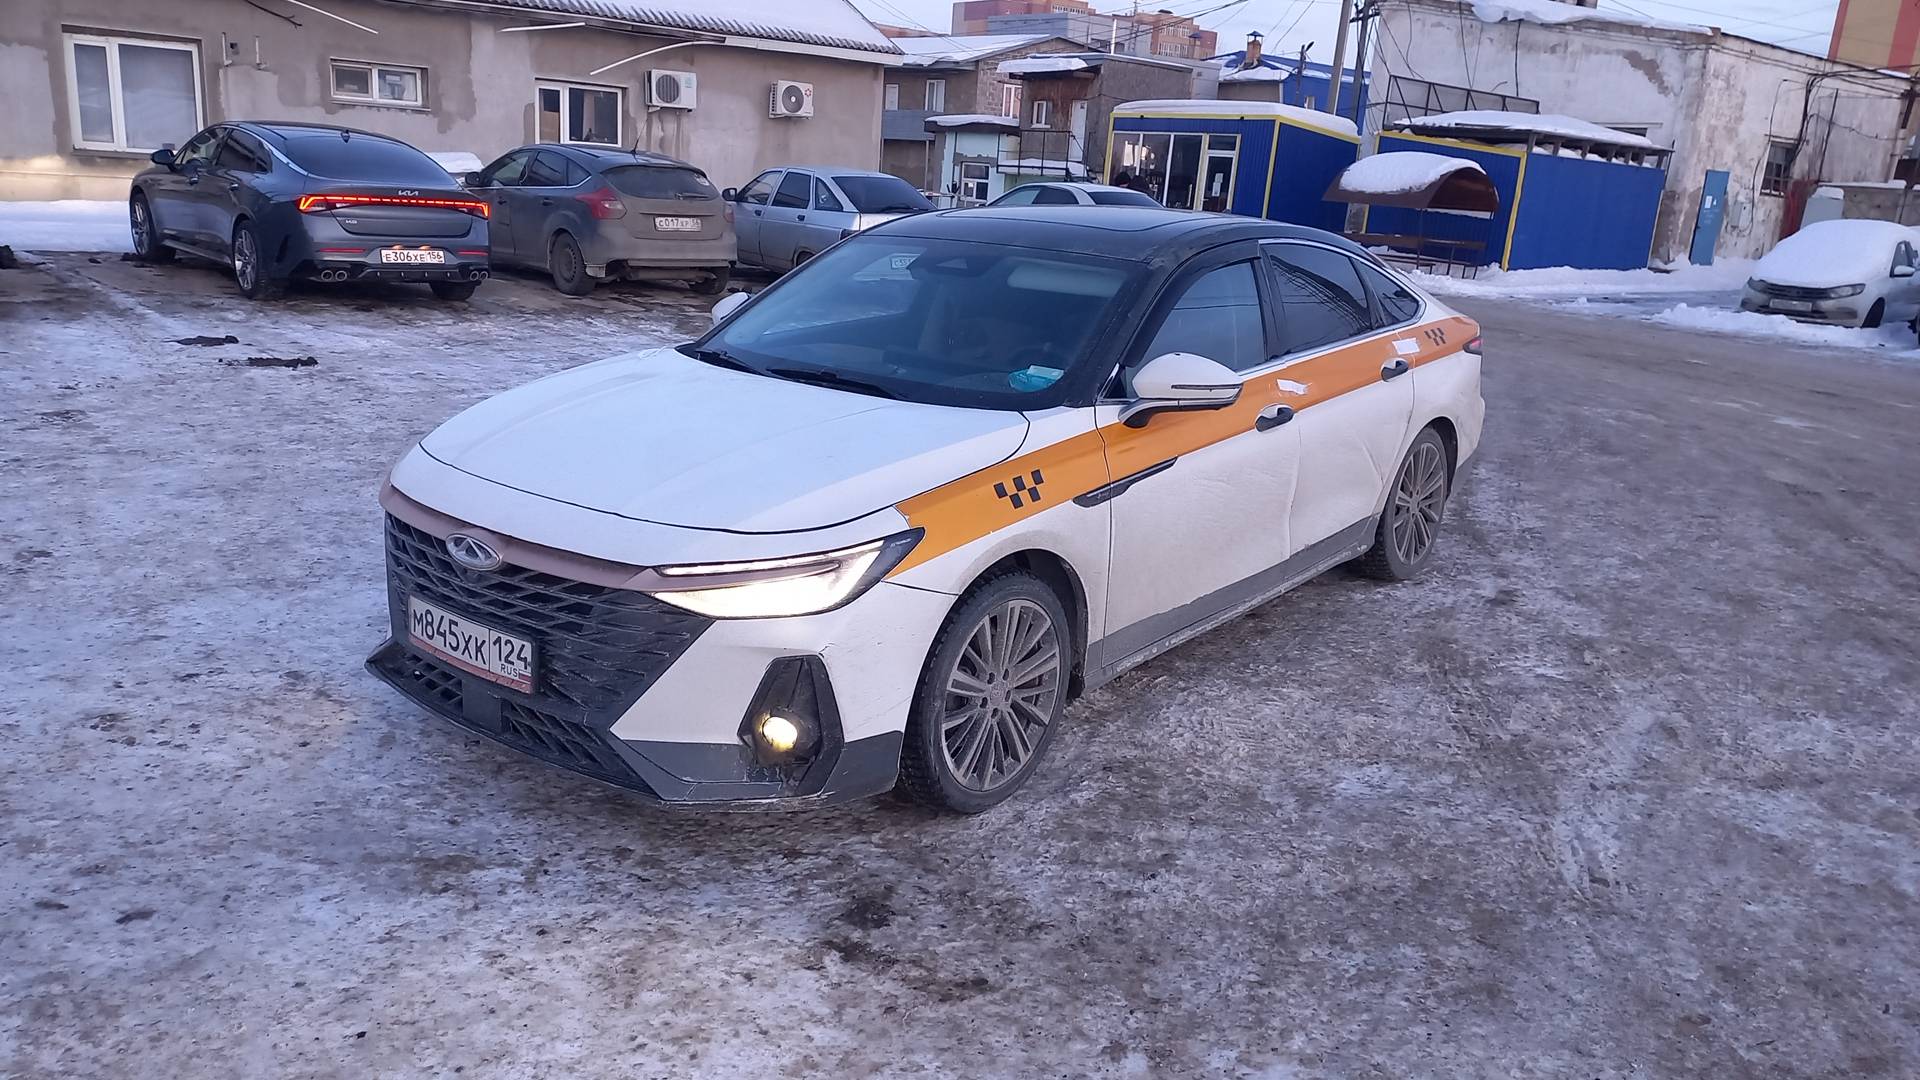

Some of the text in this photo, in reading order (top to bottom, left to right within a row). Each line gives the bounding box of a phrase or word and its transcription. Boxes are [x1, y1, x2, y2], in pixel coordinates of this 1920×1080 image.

[413, 608, 529, 670] М845ХК 124
[500, 663, 518, 678] RUS
